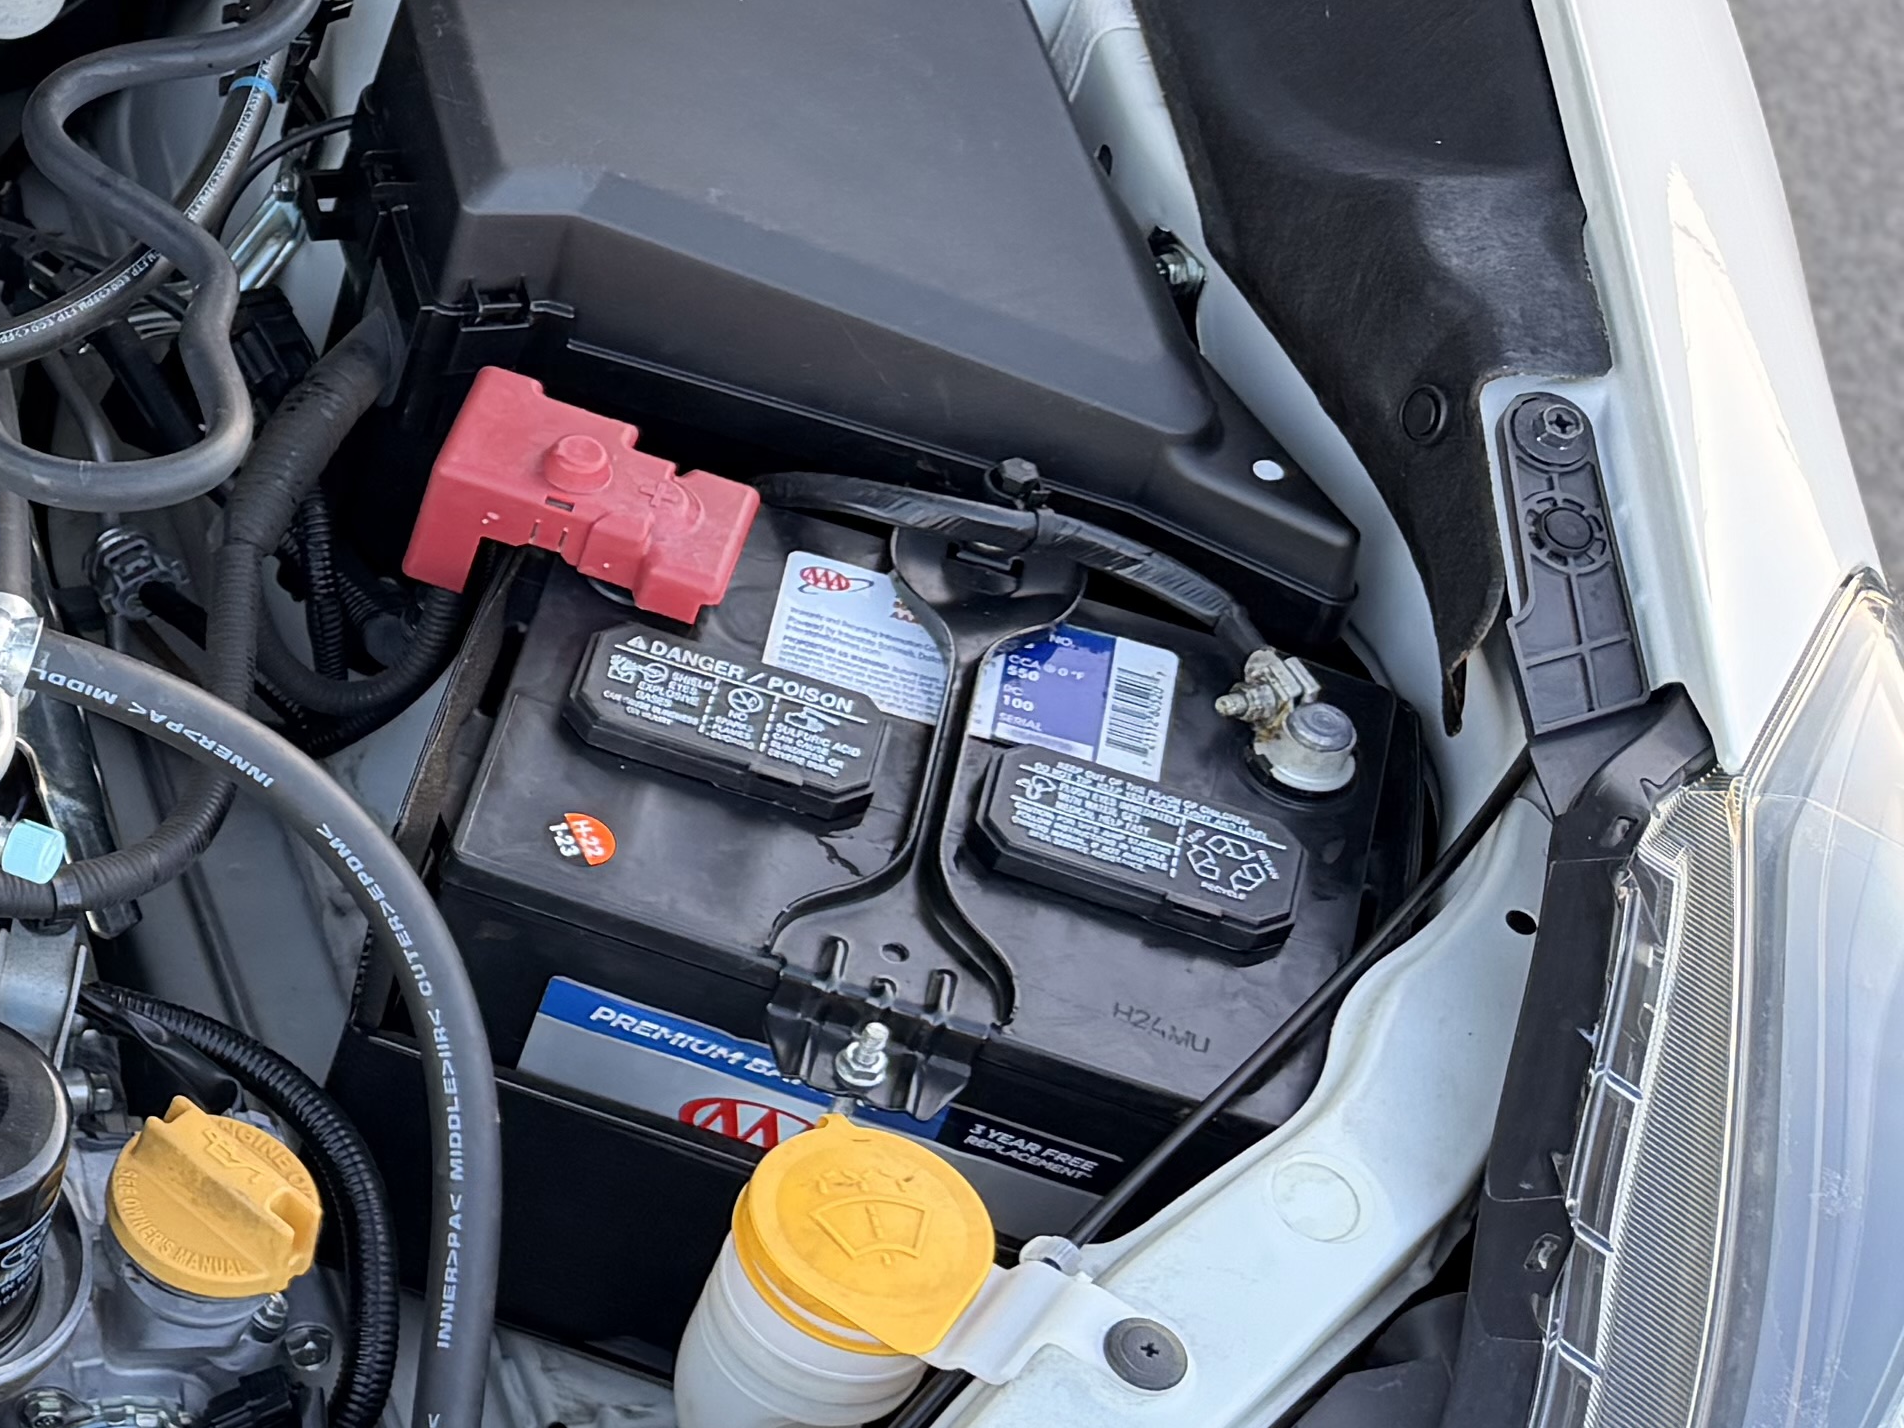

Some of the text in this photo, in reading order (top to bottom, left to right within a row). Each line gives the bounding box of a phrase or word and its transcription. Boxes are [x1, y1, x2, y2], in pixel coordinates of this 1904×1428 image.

[801, 568, 850, 592] AAA
[1008, 654, 1041, 670] CCA
[650, 640, 746, 683] DANGER
[767, 676, 855, 713] POISON
[672, 672, 713, 691] SHIELD
[1007, 667, 1040, 682] 550
[637, 681, 701, 707] EXPLOSIVE
[1002, 695, 1035, 711] 100
[728, 710, 748, 722] NO
[999, 712, 1044, 732] SERIAL
[771, 732, 830, 756] CAN CAUSE
[775, 723, 861, 758] SULFURIC ACID
[1057, 761, 1082, 776] KEEP
[1085, 768, 1108, 782] OUT
[1109, 775, 1124, 786] OF
[1146, 788, 1182, 805] REACH
[1182, 799, 1198, 811] OF
[1199, 804, 1251, 826] CHILDREN
[1057, 792, 1141, 824] WITH GET
[1098, 812, 1122, 828] HELP
[1235, 822, 1269, 840] LEVEL
[1200, 880, 1247, 901] RECYCLE
[590, 1006, 746, 1065] PREMIUM
[427, 1008, 464, 1181] MIDDLE>IIR<
[969, 1123, 1100, 1172] 3 YEAR FREE
[174, 1247, 251, 1276] MANUAL
[437, 1193, 463, 1349] INNER>PA<
